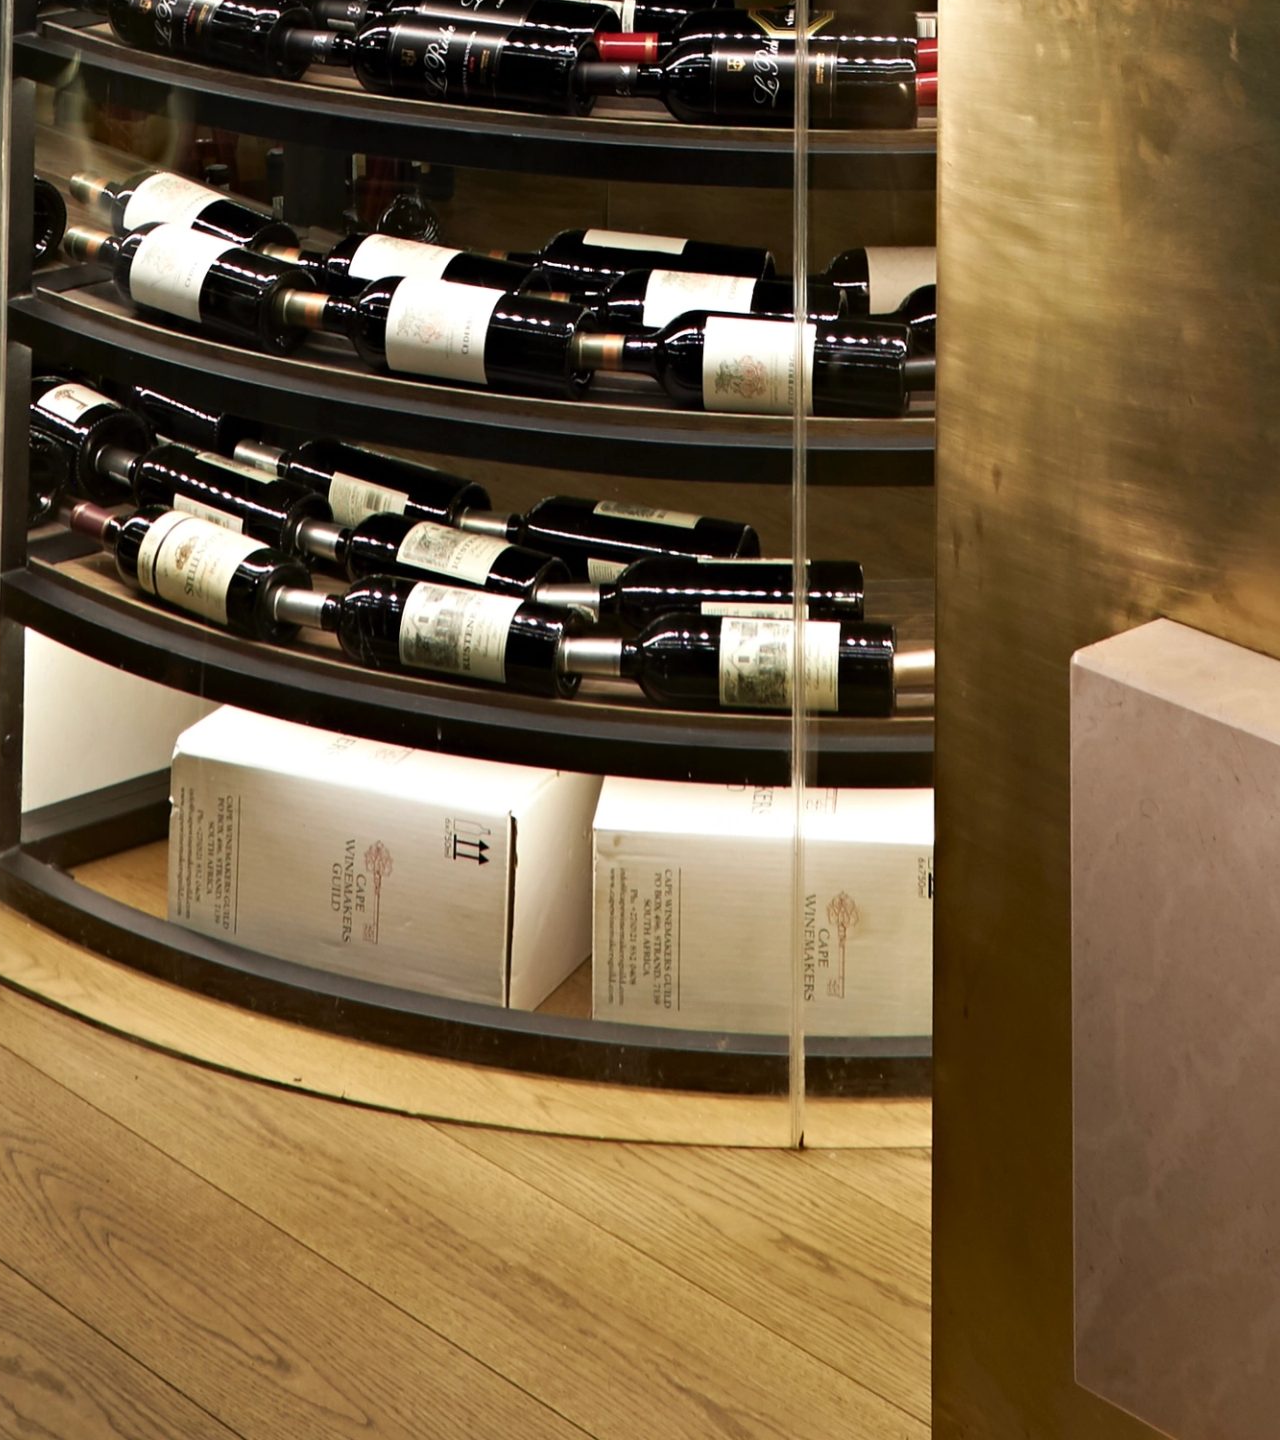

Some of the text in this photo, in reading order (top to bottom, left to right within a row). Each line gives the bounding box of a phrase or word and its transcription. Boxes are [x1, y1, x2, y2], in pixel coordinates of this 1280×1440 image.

[753, 73, 780, 108] Le
[206, 860, 214, 895] AFRICA
[224, 825, 232, 893] WINEMAKERS
[331, 862, 343, 911] GUILD
[342, 838, 356, 943] WINEMAKERS
[355, 873, 367, 913] CAPE
[654, 873, 661, 887] PO
[643, 939, 651, 975] AFRICA
[663, 869, 672, 1009] CAPE WINEMAKERS GUILD
[804, 893, 817, 1002] WINEMAKERS
[817, 928, 829, 968] CAPE
